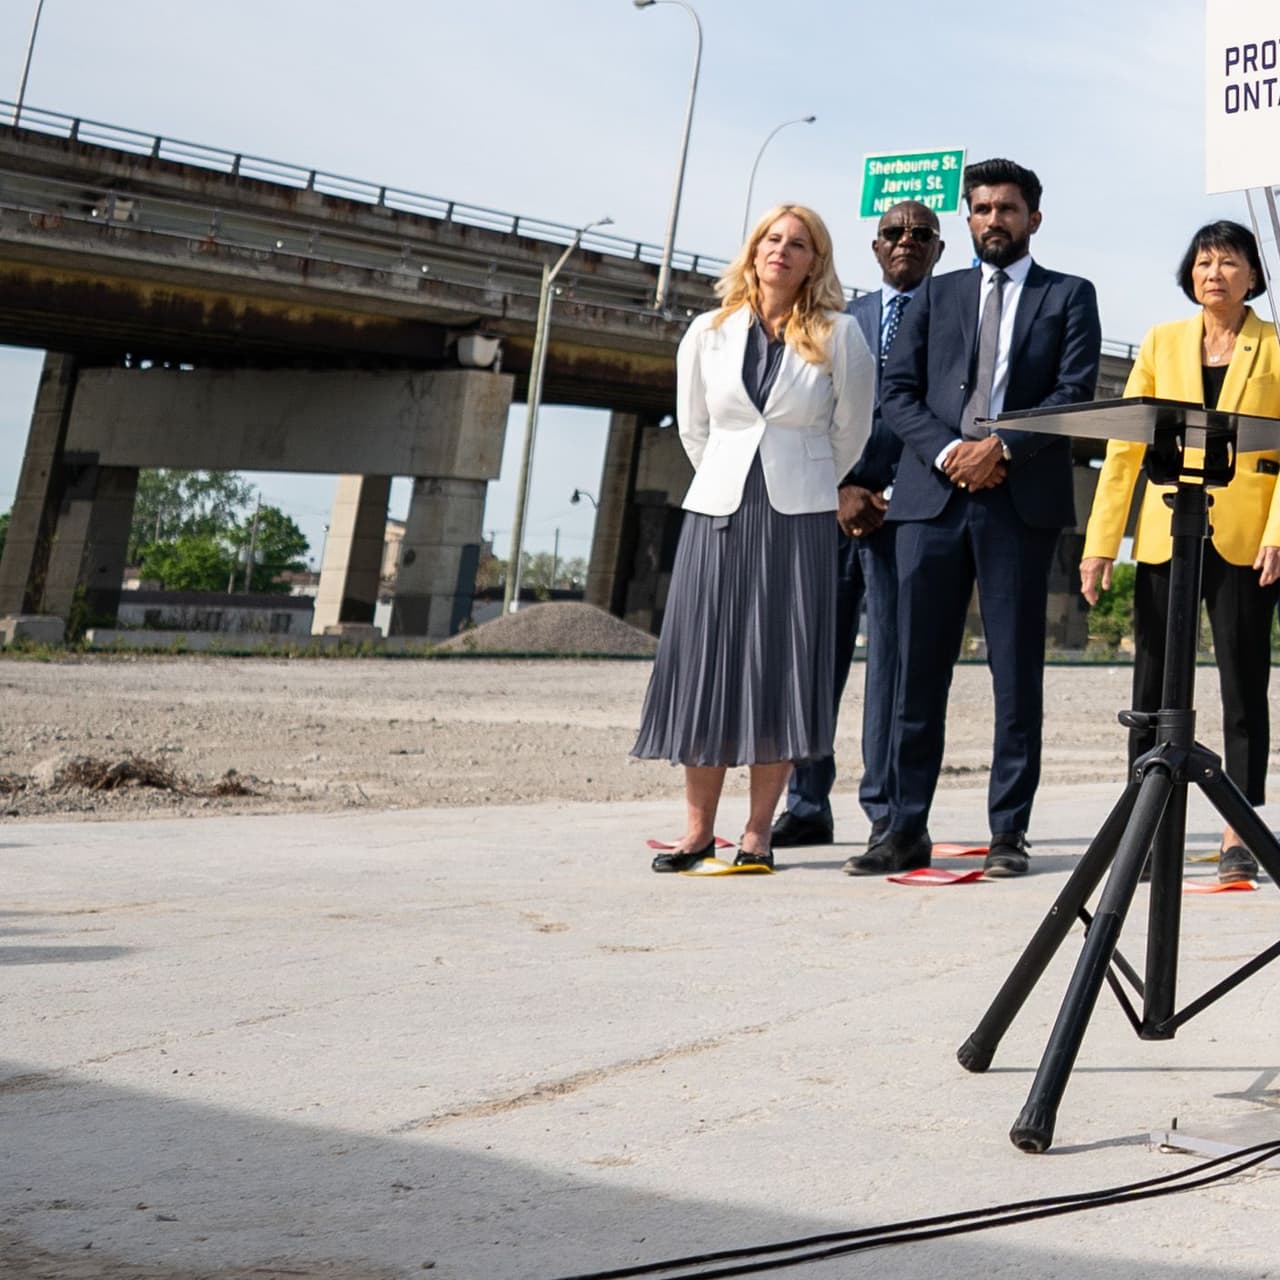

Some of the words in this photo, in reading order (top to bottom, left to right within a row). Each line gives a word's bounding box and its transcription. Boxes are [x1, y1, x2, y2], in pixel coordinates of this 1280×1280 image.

[869, 158, 939, 175] Sherbourne
[942, 154, 959, 170] St.
[881, 177, 922, 193] Jarvis
[926, 174, 944, 190] St.
[873, 196, 911, 213] NE
